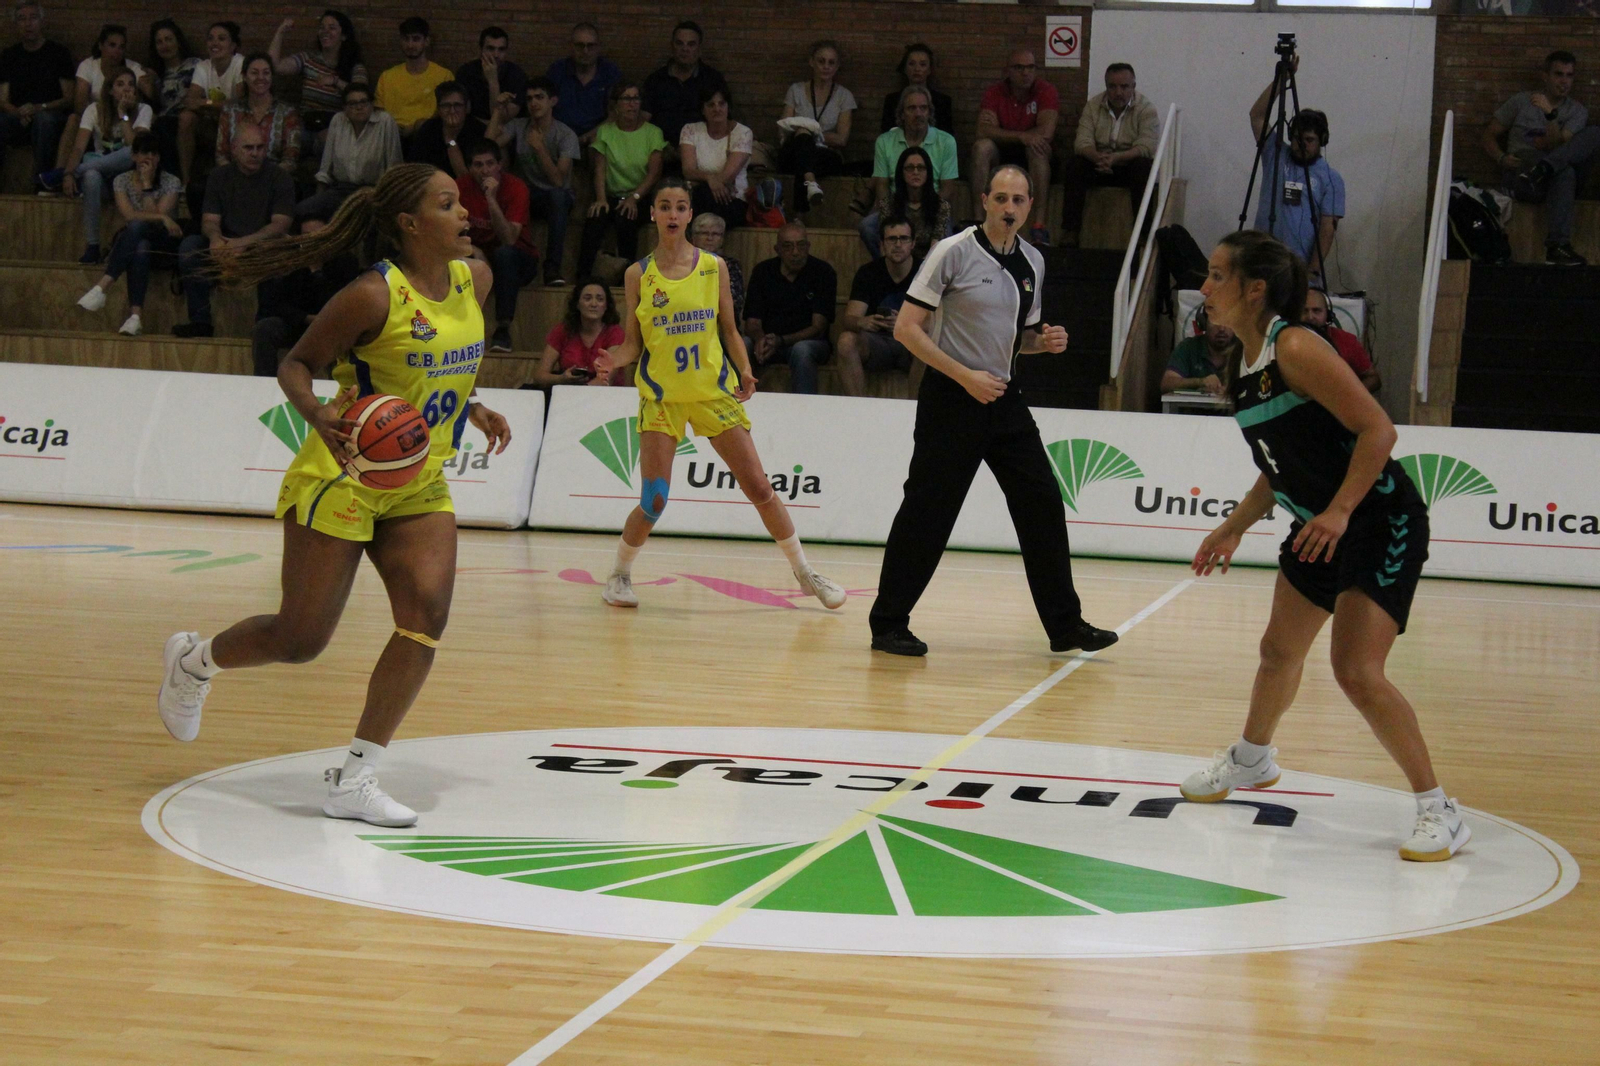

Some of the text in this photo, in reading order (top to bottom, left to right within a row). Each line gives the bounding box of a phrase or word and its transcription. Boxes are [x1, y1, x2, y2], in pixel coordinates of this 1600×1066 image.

[653, 309, 715, 327] C.B. ADAREVA
[665, 322, 706, 336] TENERIFE
[407, 340, 485, 368] C.B. ADAREV
[427, 362, 478, 379] TENERIFE
[674, 344, 700, 374] 91
[421, 389, 458, 429] 69
[1257, 438, 1280, 475] 4
[687, 462, 822, 501] Unaja
[1134, 486, 1276, 521] Unica
[1488, 502, 1600, 535] Unica
[528, 755, 1299, 828] Unicaja
